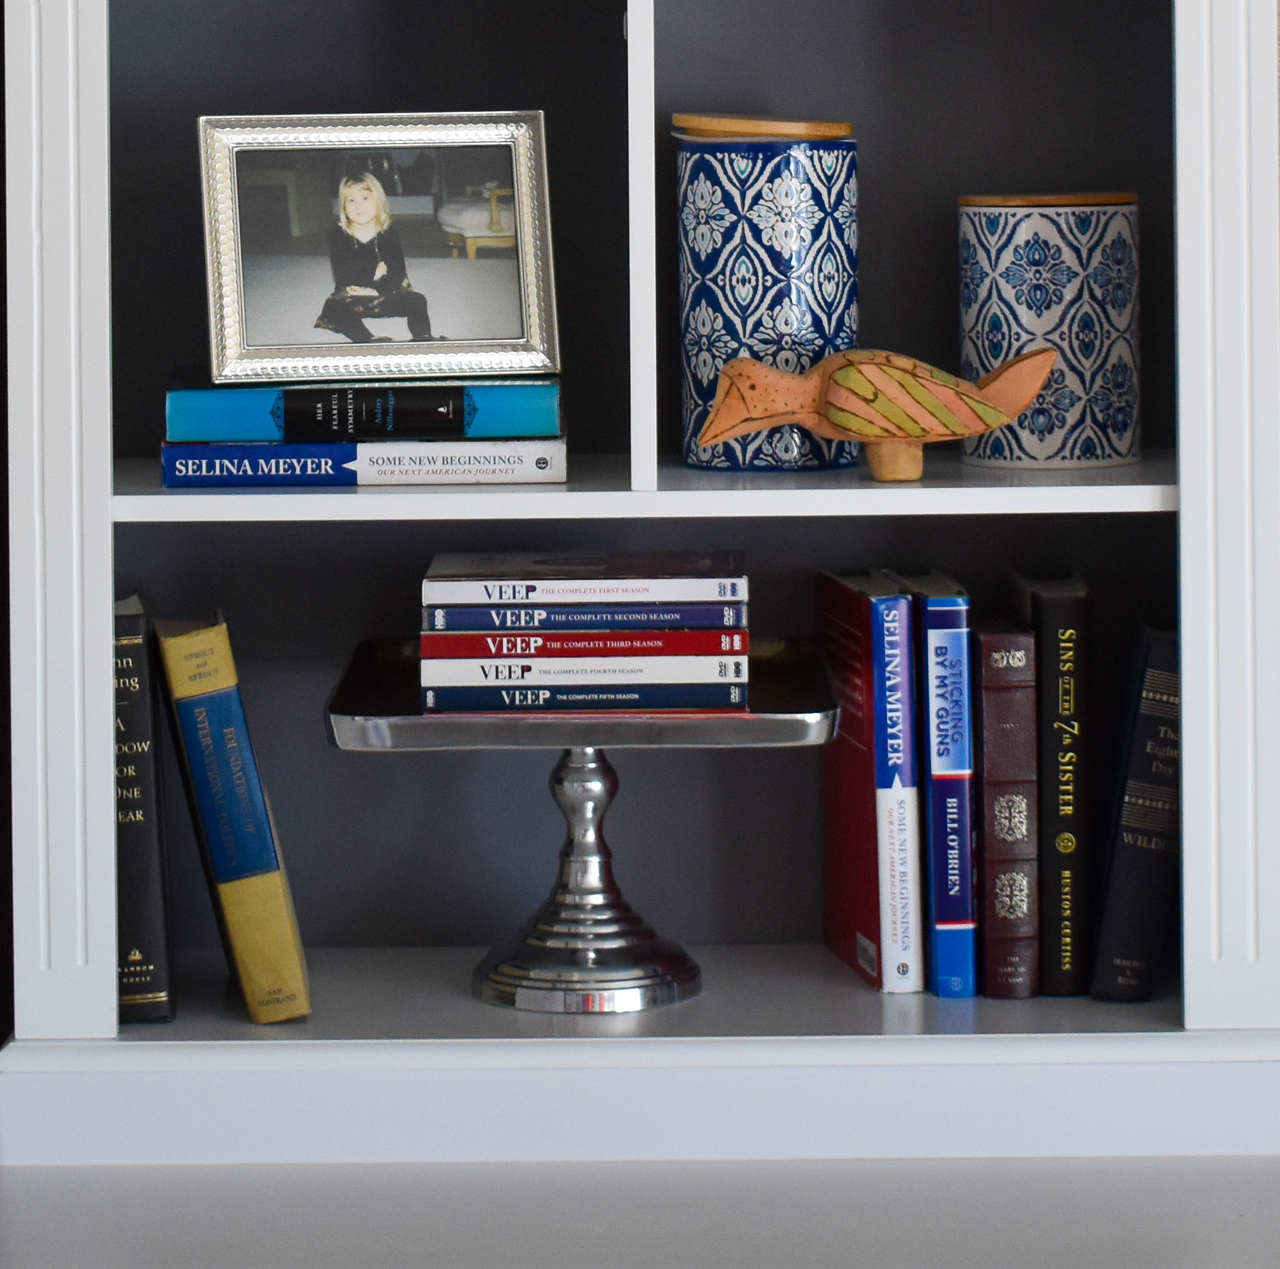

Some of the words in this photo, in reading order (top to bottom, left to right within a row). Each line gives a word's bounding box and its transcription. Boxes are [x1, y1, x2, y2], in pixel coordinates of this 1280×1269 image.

[175, 458, 254, 476] SELINA
[257, 457, 335, 475] MEYER
[369, 455, 406, 467] SOME
[408, 455, 439, 466] NEW
[441, 454, 524, 467] BEGINNINGS
[377, 468, 395, 476] OUR
[397, 468, 420, 476] NEXT
[422, 468, 472, 476] AMERICAN
[474, 467, 516, 476] JOURNEY
[483, 584, 538, 600] VEEP
[434, 609, 444, 629] HBO
[490, 609, 547, 627] VEEP
[567, 613, 612, 621] COMPLETE
[648, 612, 681, 620] SEASON
[184, 647, 215, 662] SPROUT
[486, 636, 544, 654] VEEP
[546, 640, 562, 648] THE
[563, 640, 604, 648] COMPLETE
[606, 639, 631, 647] THIRD
[632, 639, 663, 647] SEASON
[883, 609, 901, 687] SELINA
[934, 646, 948, 669] BY
[1058, 629, 1077, 671] SINS
[480, 664, 532, 680] VEEP
[501, 689, 551, 705] VEEP
[934, 675, 949, 700] MY
[950, 658, 964, 743] STICKING
[886, 692, 904, 766] MEYER
[935, 708, 950, 758] GUNS
[1058, 752, 1077, 816] SISTER
[896, 799, 907, 836] SOME
[946, 797, 959, 832] BILL
[898, 841, 907, 866] NEW
[946, 835, 960, 896] O'BRIEN
[1061, 870, 1072, 917] HUSTON
[899, 870, 911, 952] BEGINNINGS
[1061, 921, 1072, 971] CURTISS
